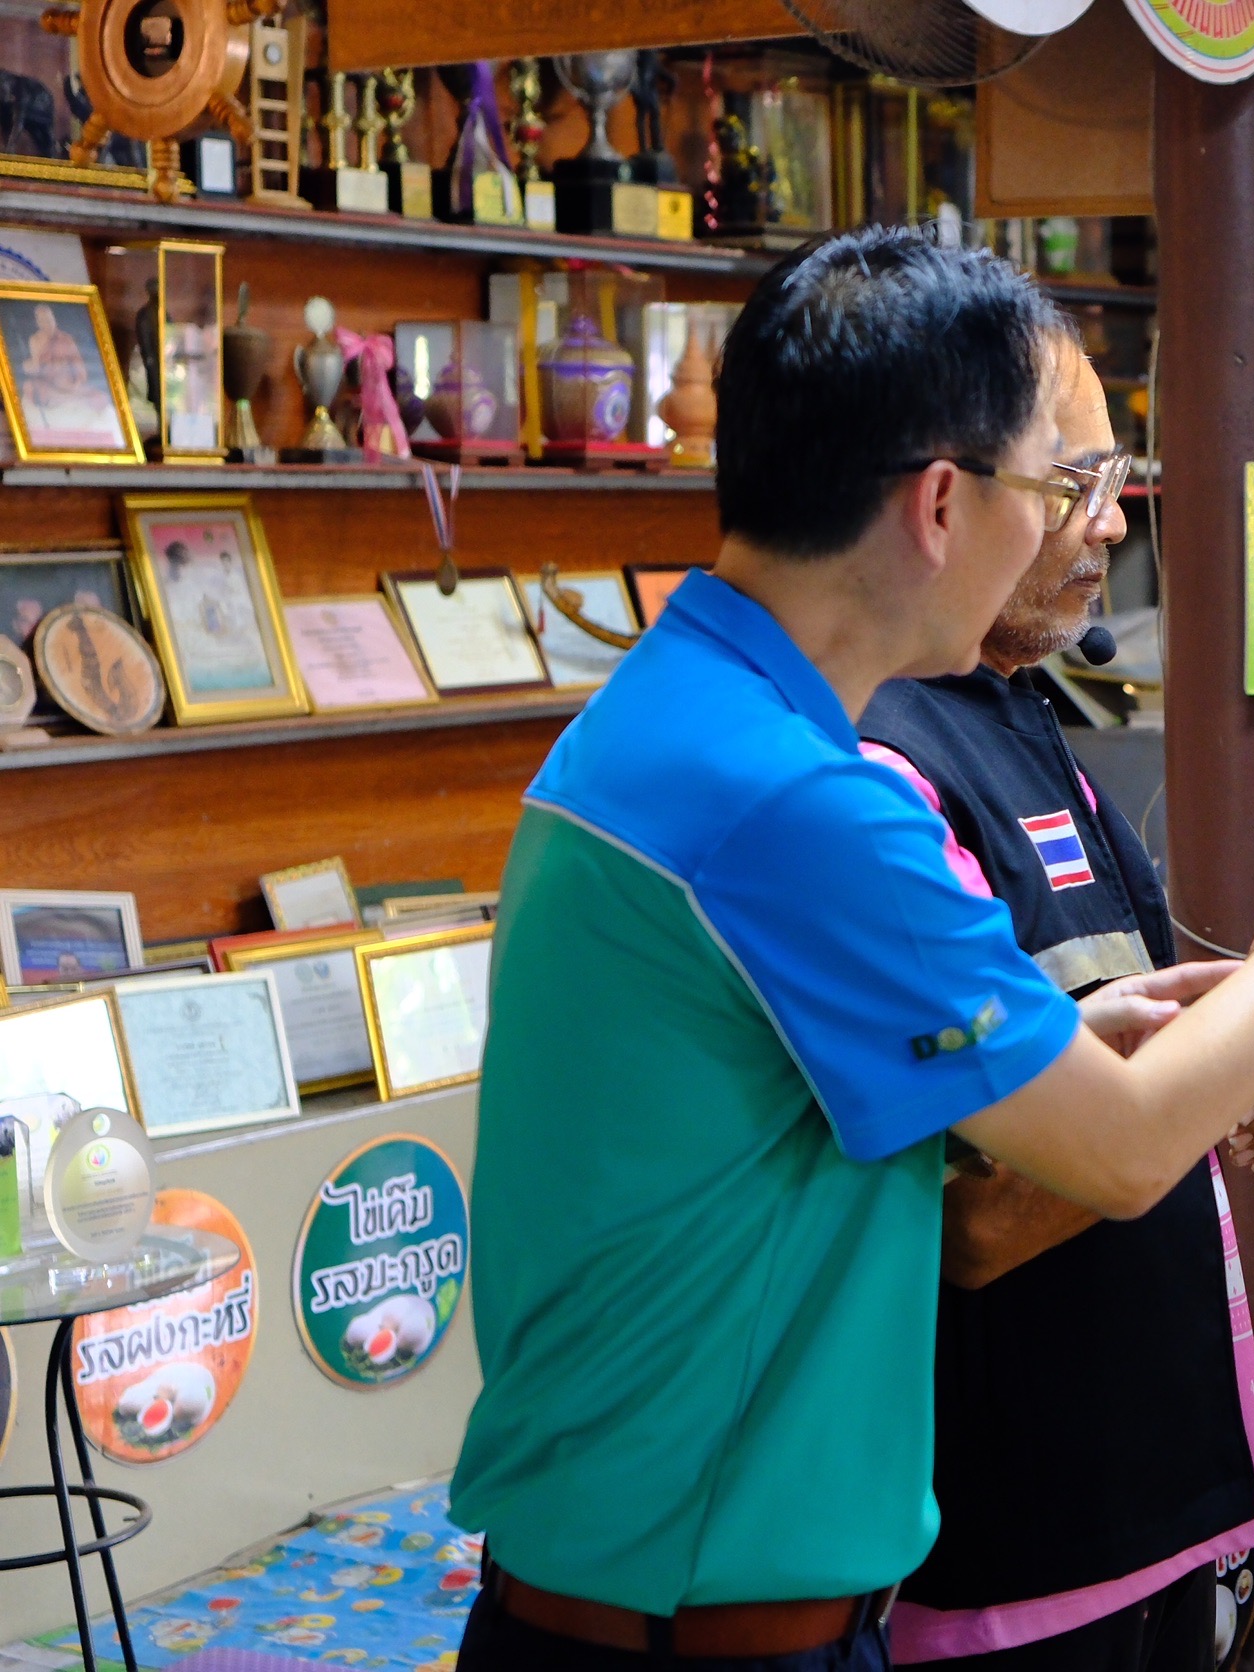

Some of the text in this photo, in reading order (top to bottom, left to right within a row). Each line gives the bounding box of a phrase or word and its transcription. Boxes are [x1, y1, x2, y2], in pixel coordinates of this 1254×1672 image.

[322, 1174, 432, 1243] ไข่เค็ม
[312, 1235, 461, 1310] รสมะกรูด
[77, 1271, 251, 1382] รสผงกะหรี่
